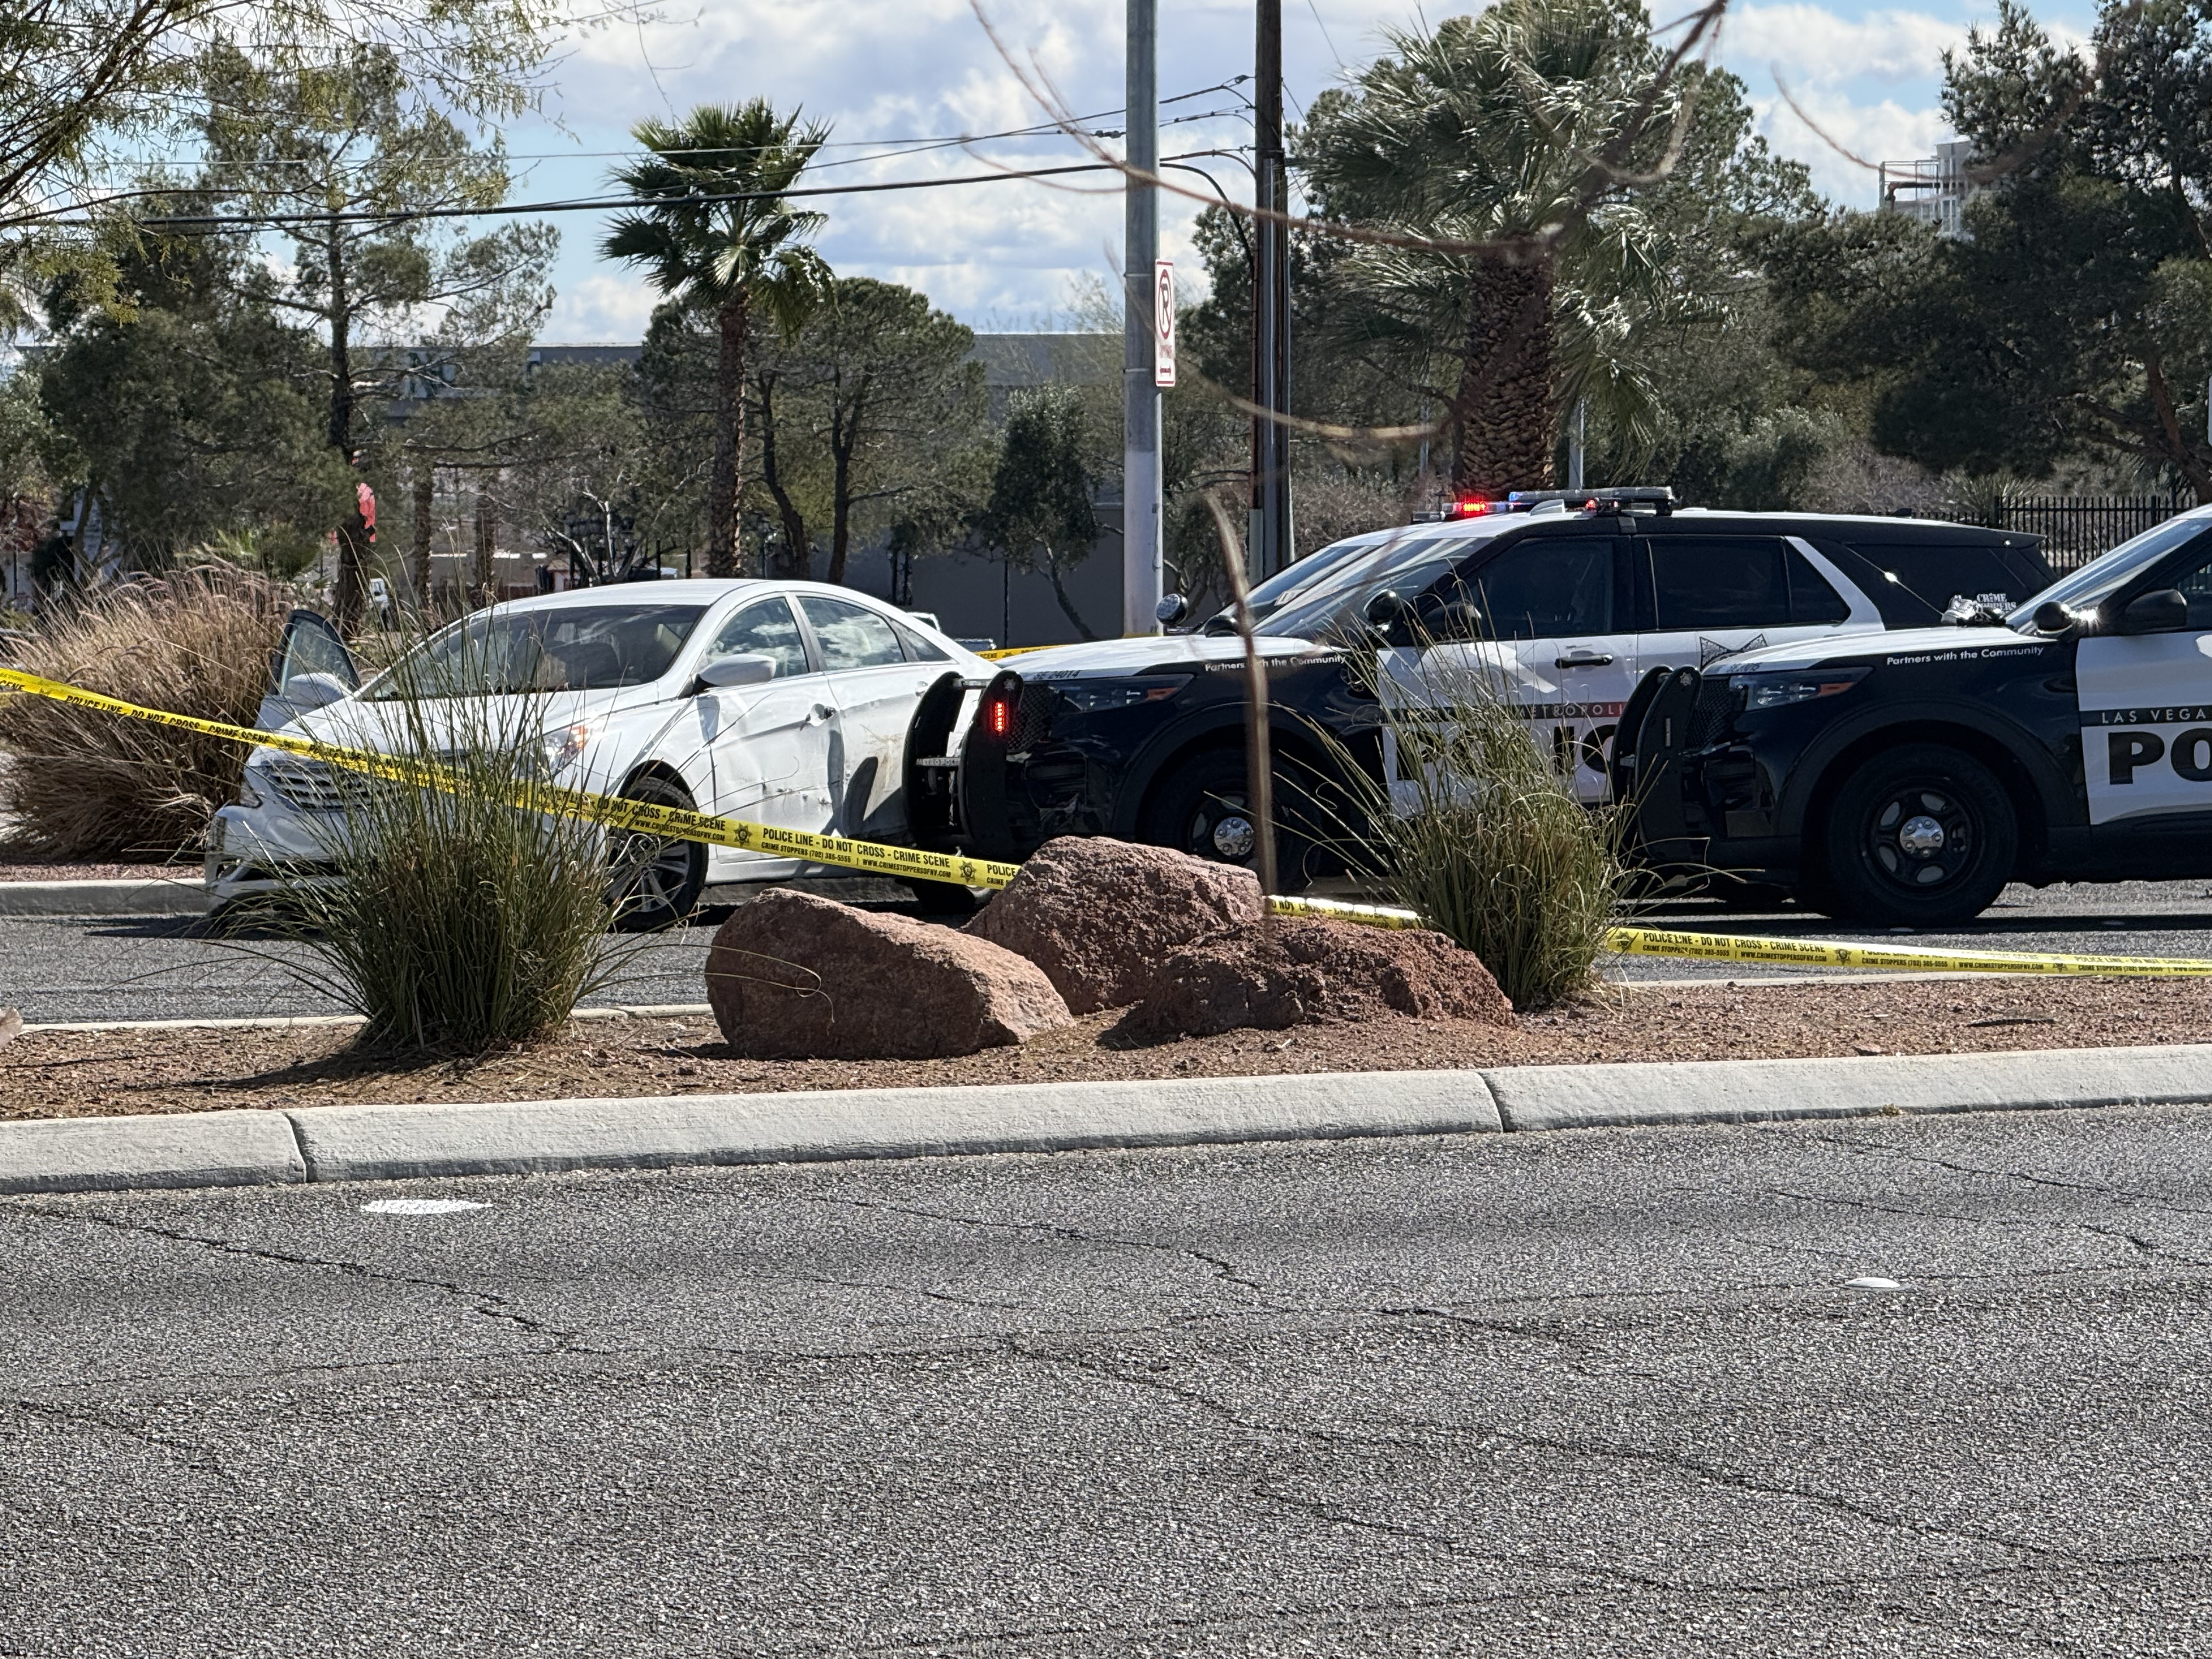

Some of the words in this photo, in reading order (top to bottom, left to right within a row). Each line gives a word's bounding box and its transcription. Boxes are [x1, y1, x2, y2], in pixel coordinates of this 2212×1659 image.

[1887, 654, 1931, 665] Partners
[1933, 652, 1957, 662] with
[1960, 651, 1978, 659] the
[1981, 646, 2044, 658] Community
[1048, 669, 1081, 679] 24014
[1205, 662, 1245, 672] Partners
[1272, 658, 1288, 667] the
[66, 695, 100, 708] POLICE
[101, 702, 123, 713] LINE
[130, 709, 145, 719] DO
[146, 712, 166, 722] NOT
[167, 717, 201, 729] CROSS
[207, 725, 239, 737] CRIME
[241, 730, 269, 743] SCENE
[2102, 710, 2137, 724] LAS
[2150, 708, 2212, 721] VEGA
[632, 804, 661, 820] CROSS
[669, 811, 697, 826] CRIME
[698, 816, 726, 832] SCENE
[761, 842, 779, 851] CRIME
[780, 844, 808, 856] STOPPERS
[809, 850, 823, 860] (702)
[763, 828, 793, 843] POLICE
[795, 833, 814, 847] LINE
[822, 838, 833, 850] DO
[836, 840, 853, 853] NOT
[857, 844, 885, 858] CROSS
[894, 850, 921, 864] CRIME
[923, 854, 950, 868] SCENE
[987, 864, 1015, 877] POLICE
[986, 877, 1004, 886] CRIME
[1643, 932, 1673, 943] POLICE
[1675, 934, 1694, 945] LINE
[1701, 936, 1713, 946] DO
[1715, 938, 1730, 948] NOT
[1735, 939, 1763, 950] CROSS
[1770, 941, 1798, 951] CRIME
[1798, 943, 1826, 953] SCENE
